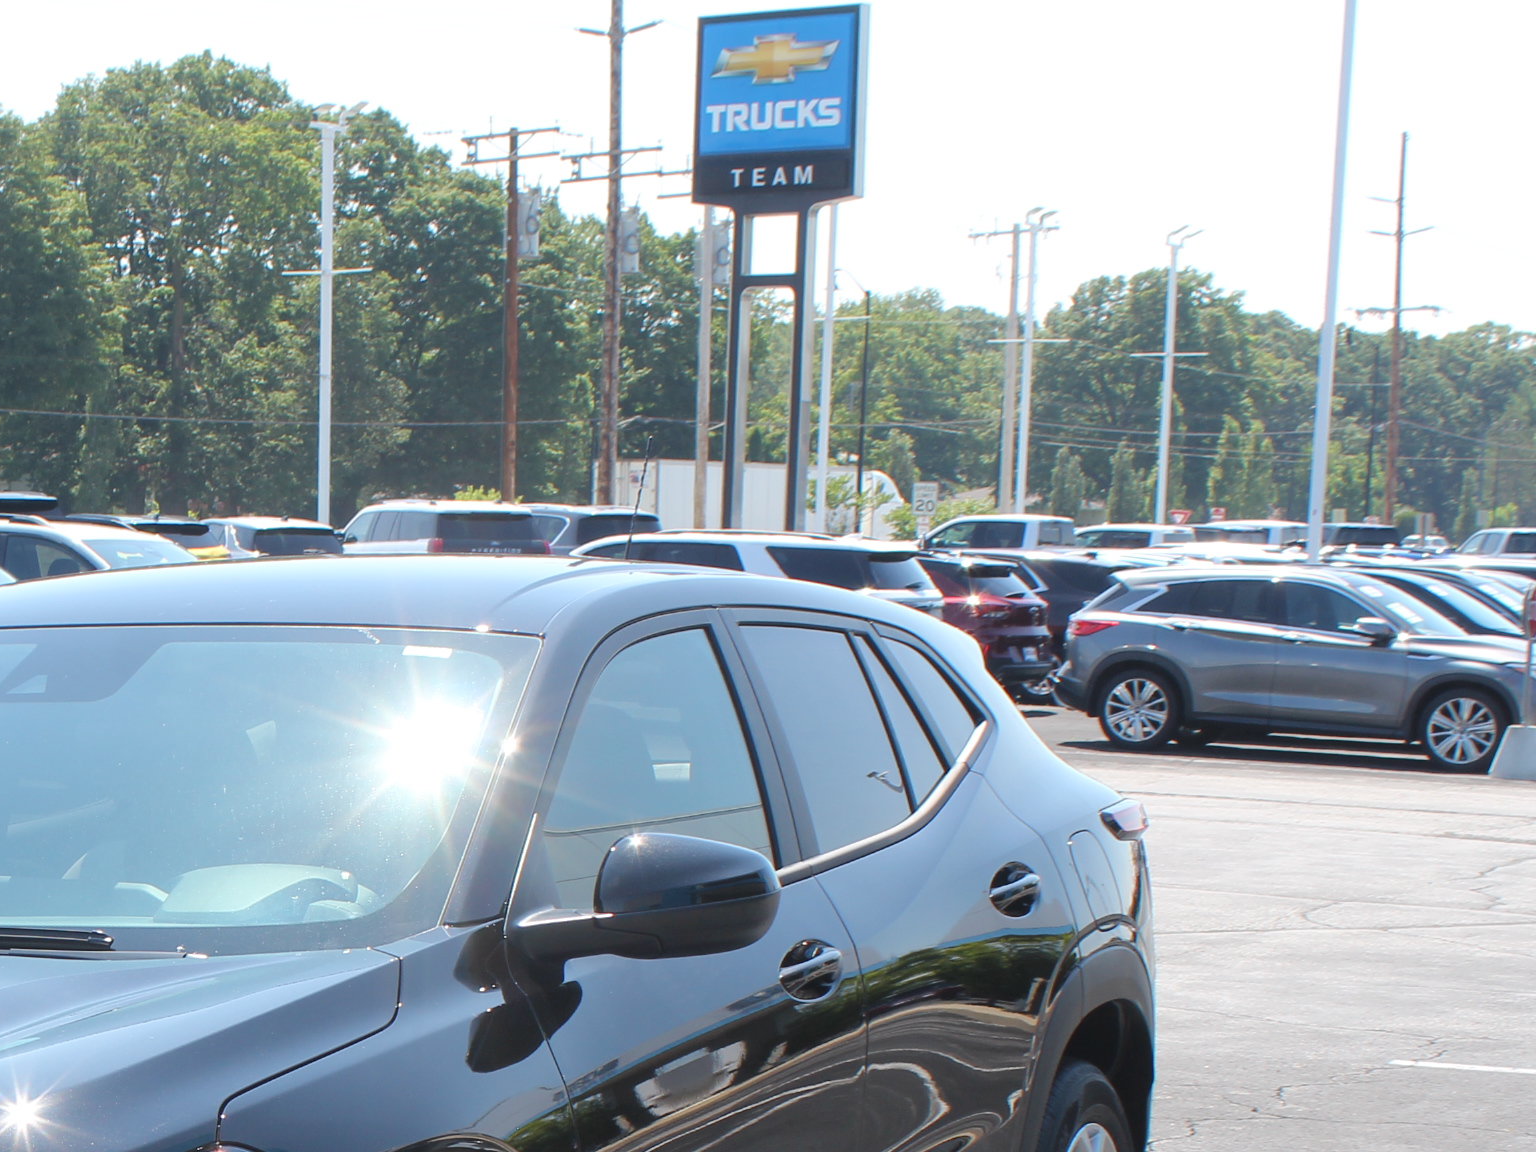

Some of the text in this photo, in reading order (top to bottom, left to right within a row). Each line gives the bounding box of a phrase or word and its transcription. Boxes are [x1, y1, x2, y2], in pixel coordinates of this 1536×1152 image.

[706, 97, 841, 133] TRUCKS
[730, 164, 814, 188] TEAM
[915, 499, 935, 512] 20
